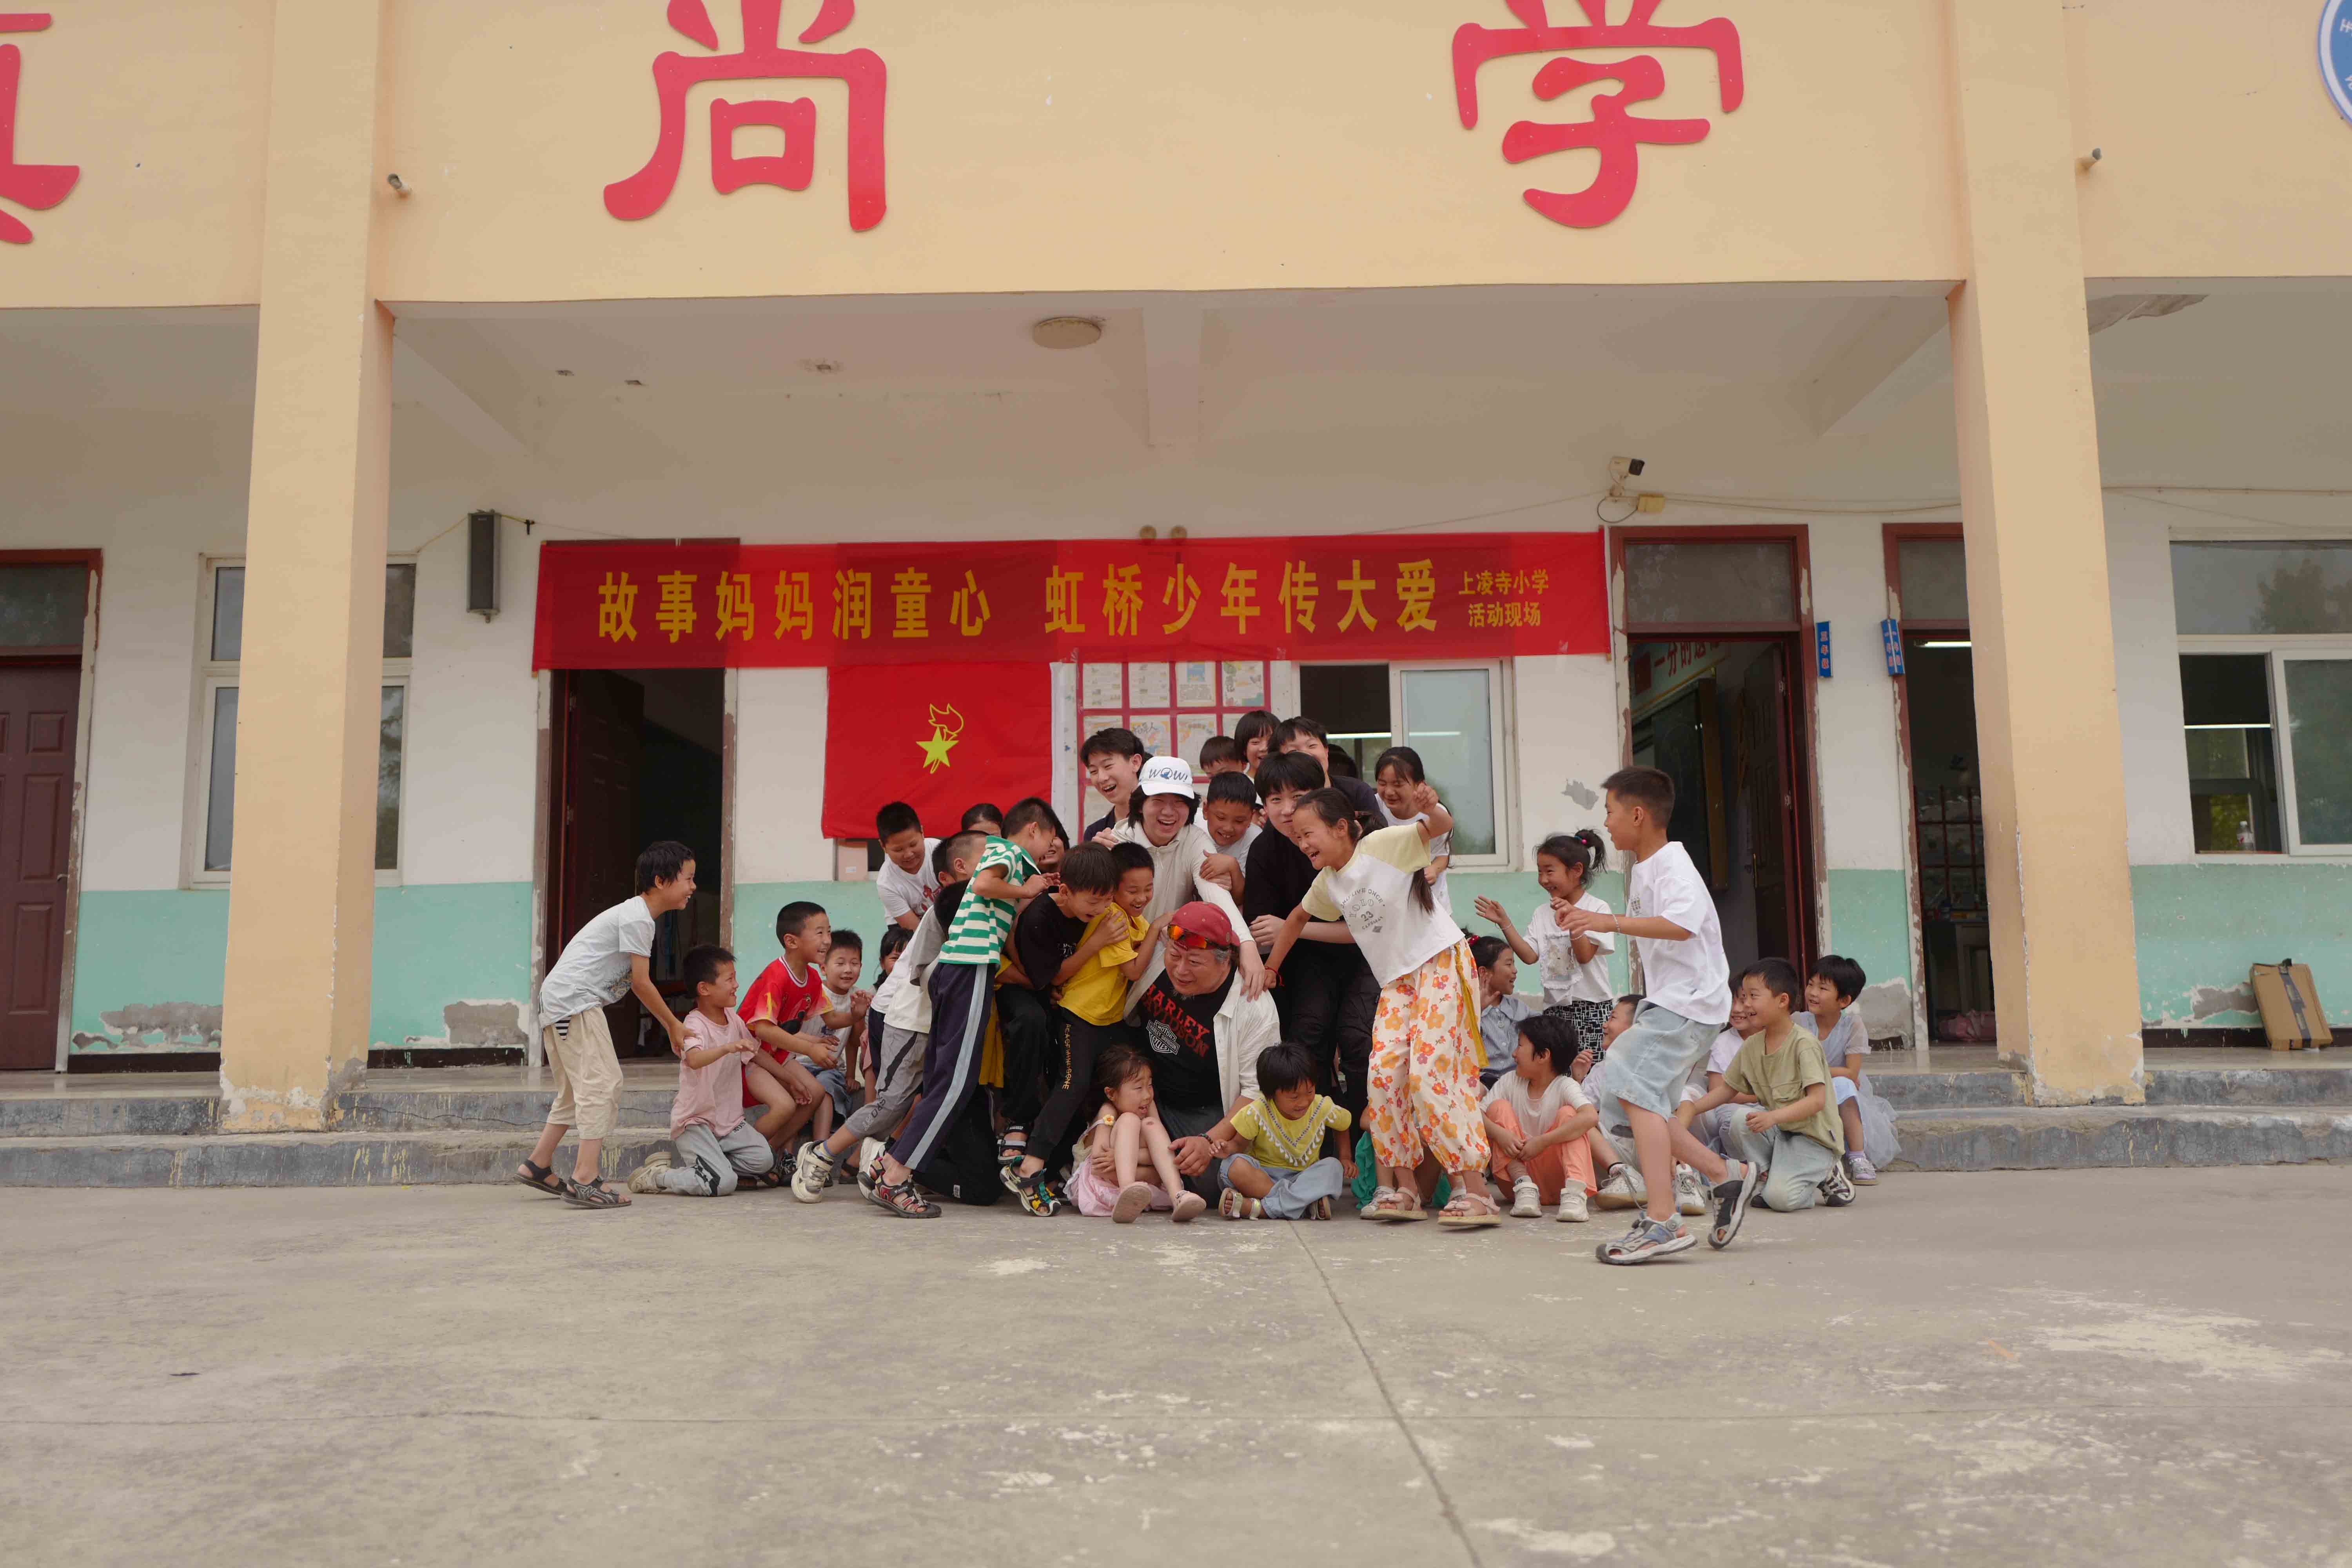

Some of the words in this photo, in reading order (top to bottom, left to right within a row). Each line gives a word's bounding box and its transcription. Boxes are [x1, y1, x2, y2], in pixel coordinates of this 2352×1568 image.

[603, 0, 887, 232] 尚
[1452, 0, 1744, 228] 学
[598, 566, 991, 643] 故事妈妈润童心
[1045, 558, 1437, 636] 虹桥少年传大爱
[1468, 601, 1541, 627] 活动现场
[1352, 887, 1366, 897] LIVE
[1368, 888, 1383, 904] ONCE
[1152, 1036, 1168, 1051] CYCLES
